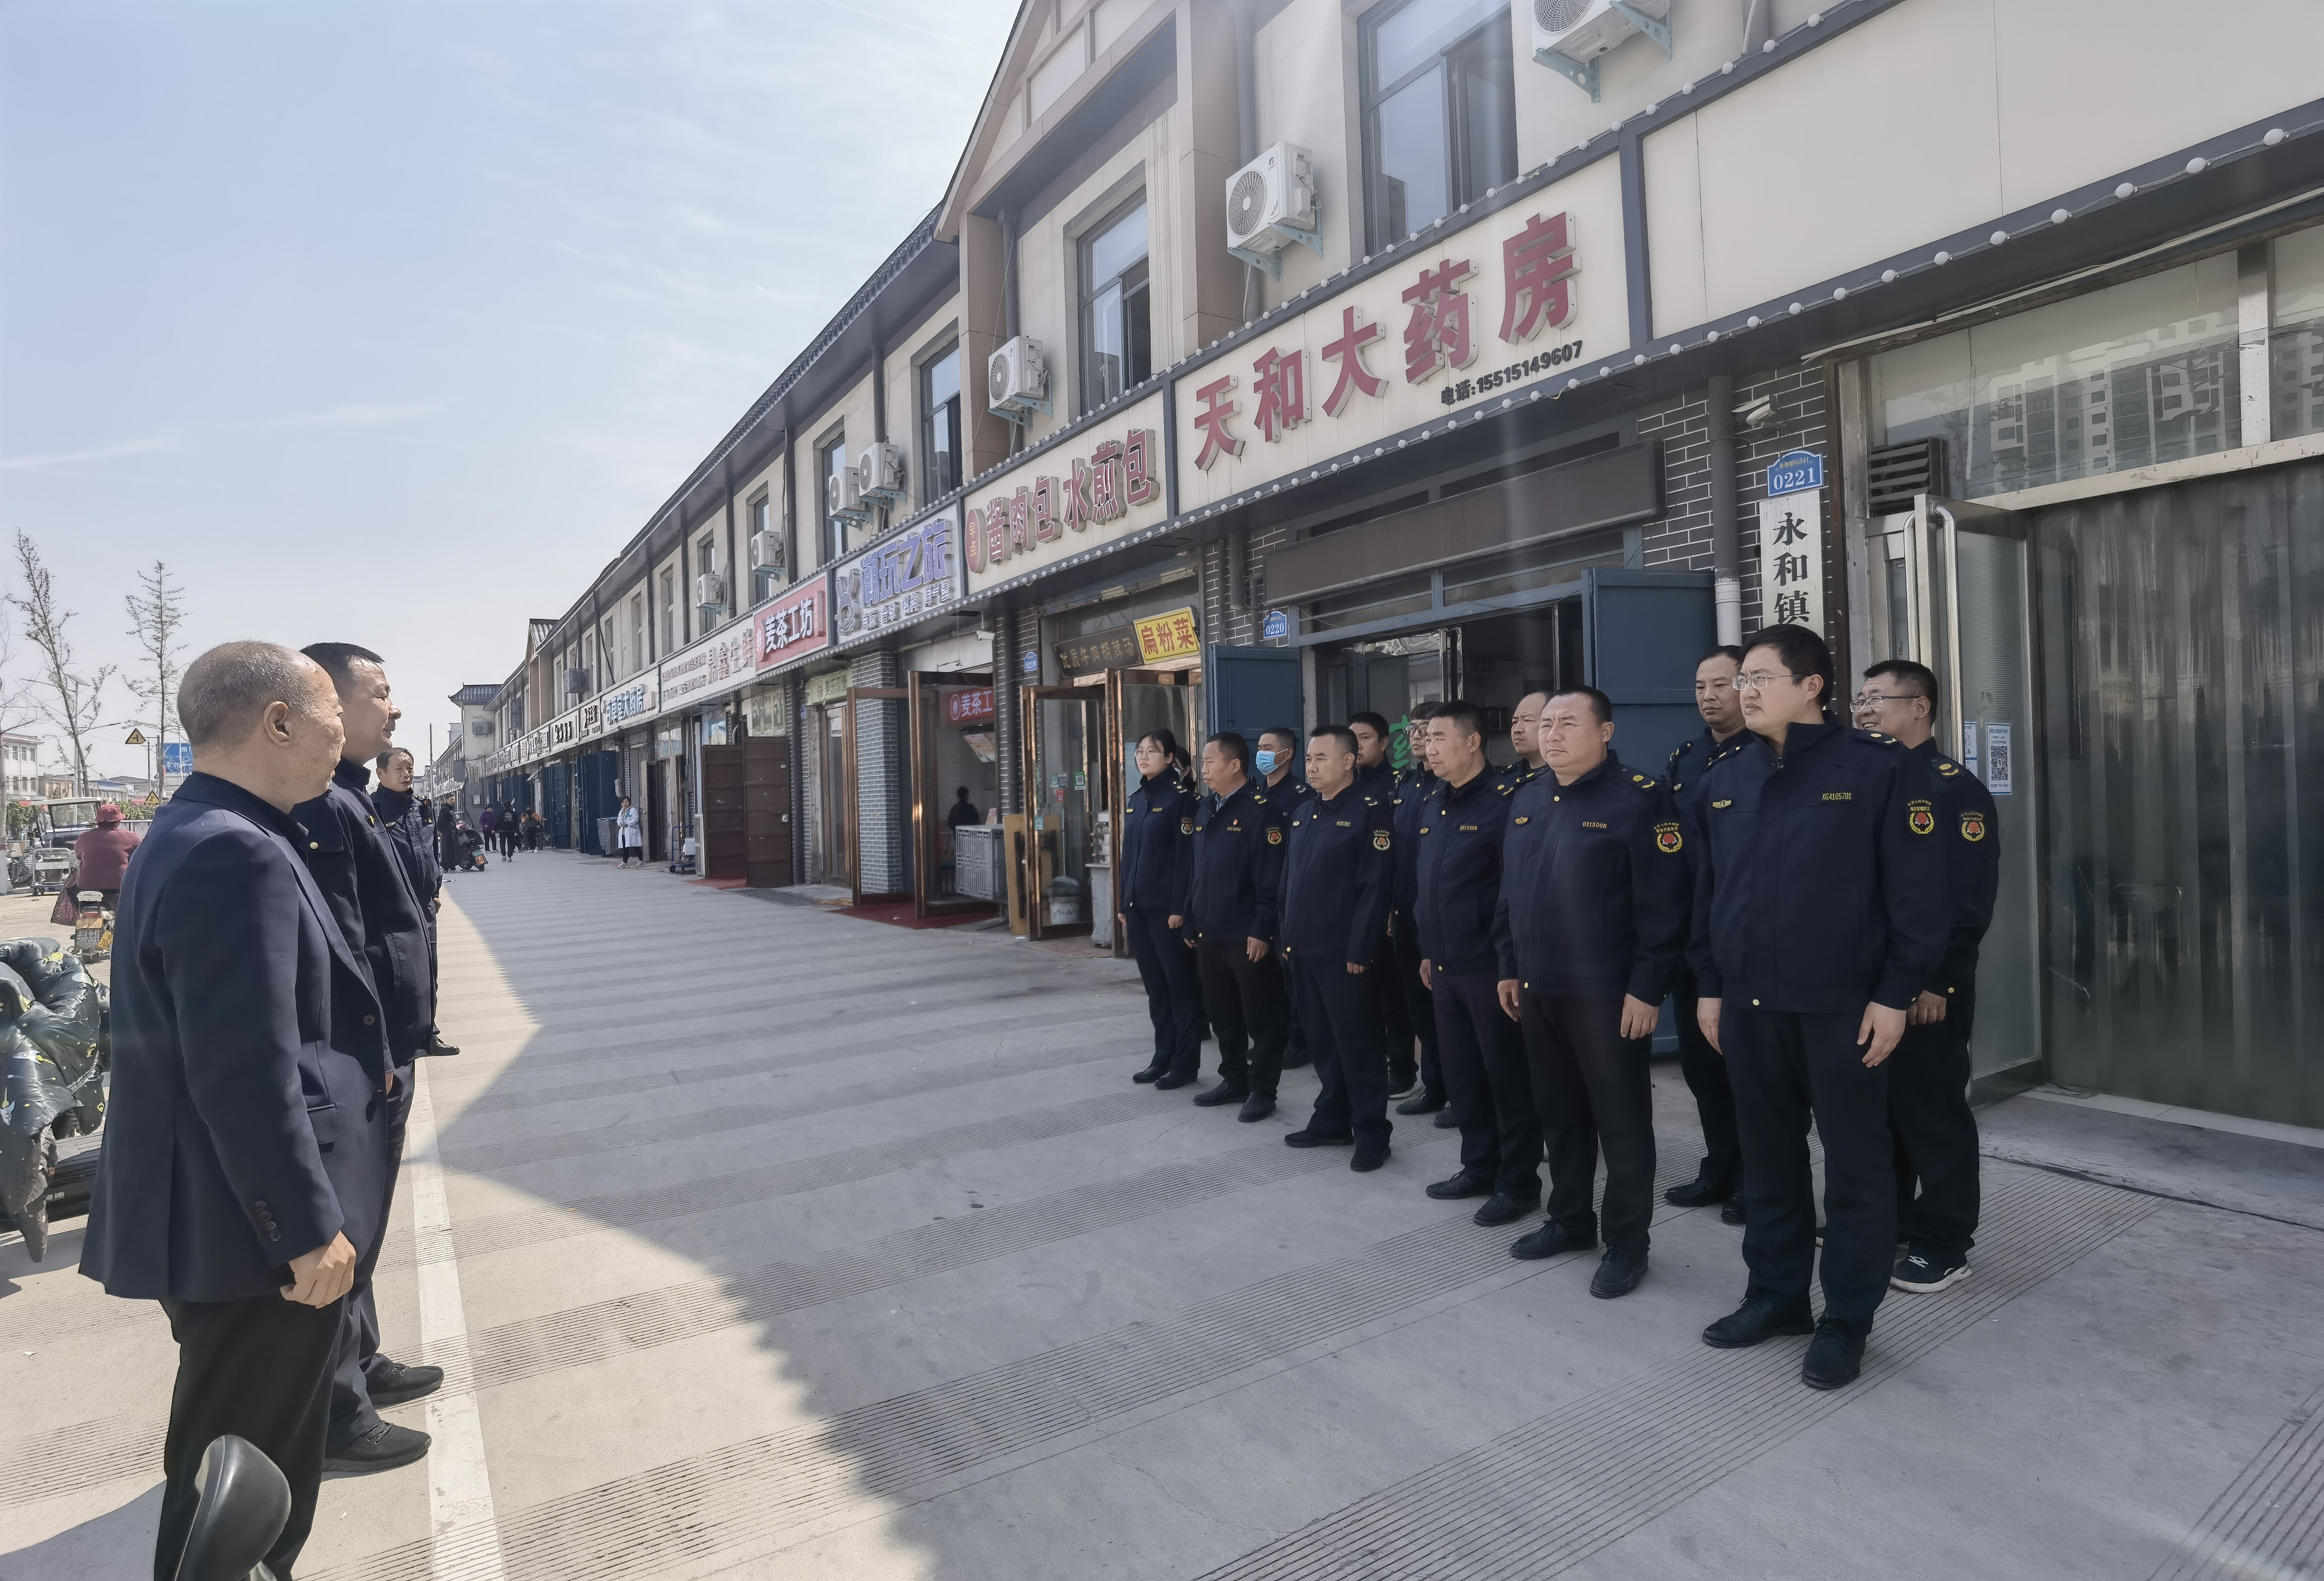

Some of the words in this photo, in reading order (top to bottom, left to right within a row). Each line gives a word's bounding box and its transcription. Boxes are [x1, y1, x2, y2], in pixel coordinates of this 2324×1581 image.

[1194, 211, 1581, 470] 天和大药房
[1774, 467, 1816, 490] 0221
[969, 522, 977, 558] 早点
[860, 519, 951, 608] 潮玩之旅
[1772, 512, 1810, 625] 永和镇
[1140, 617, 1195, 655] 扁粉菜
[1266, 623, 1284, 635] 0220
